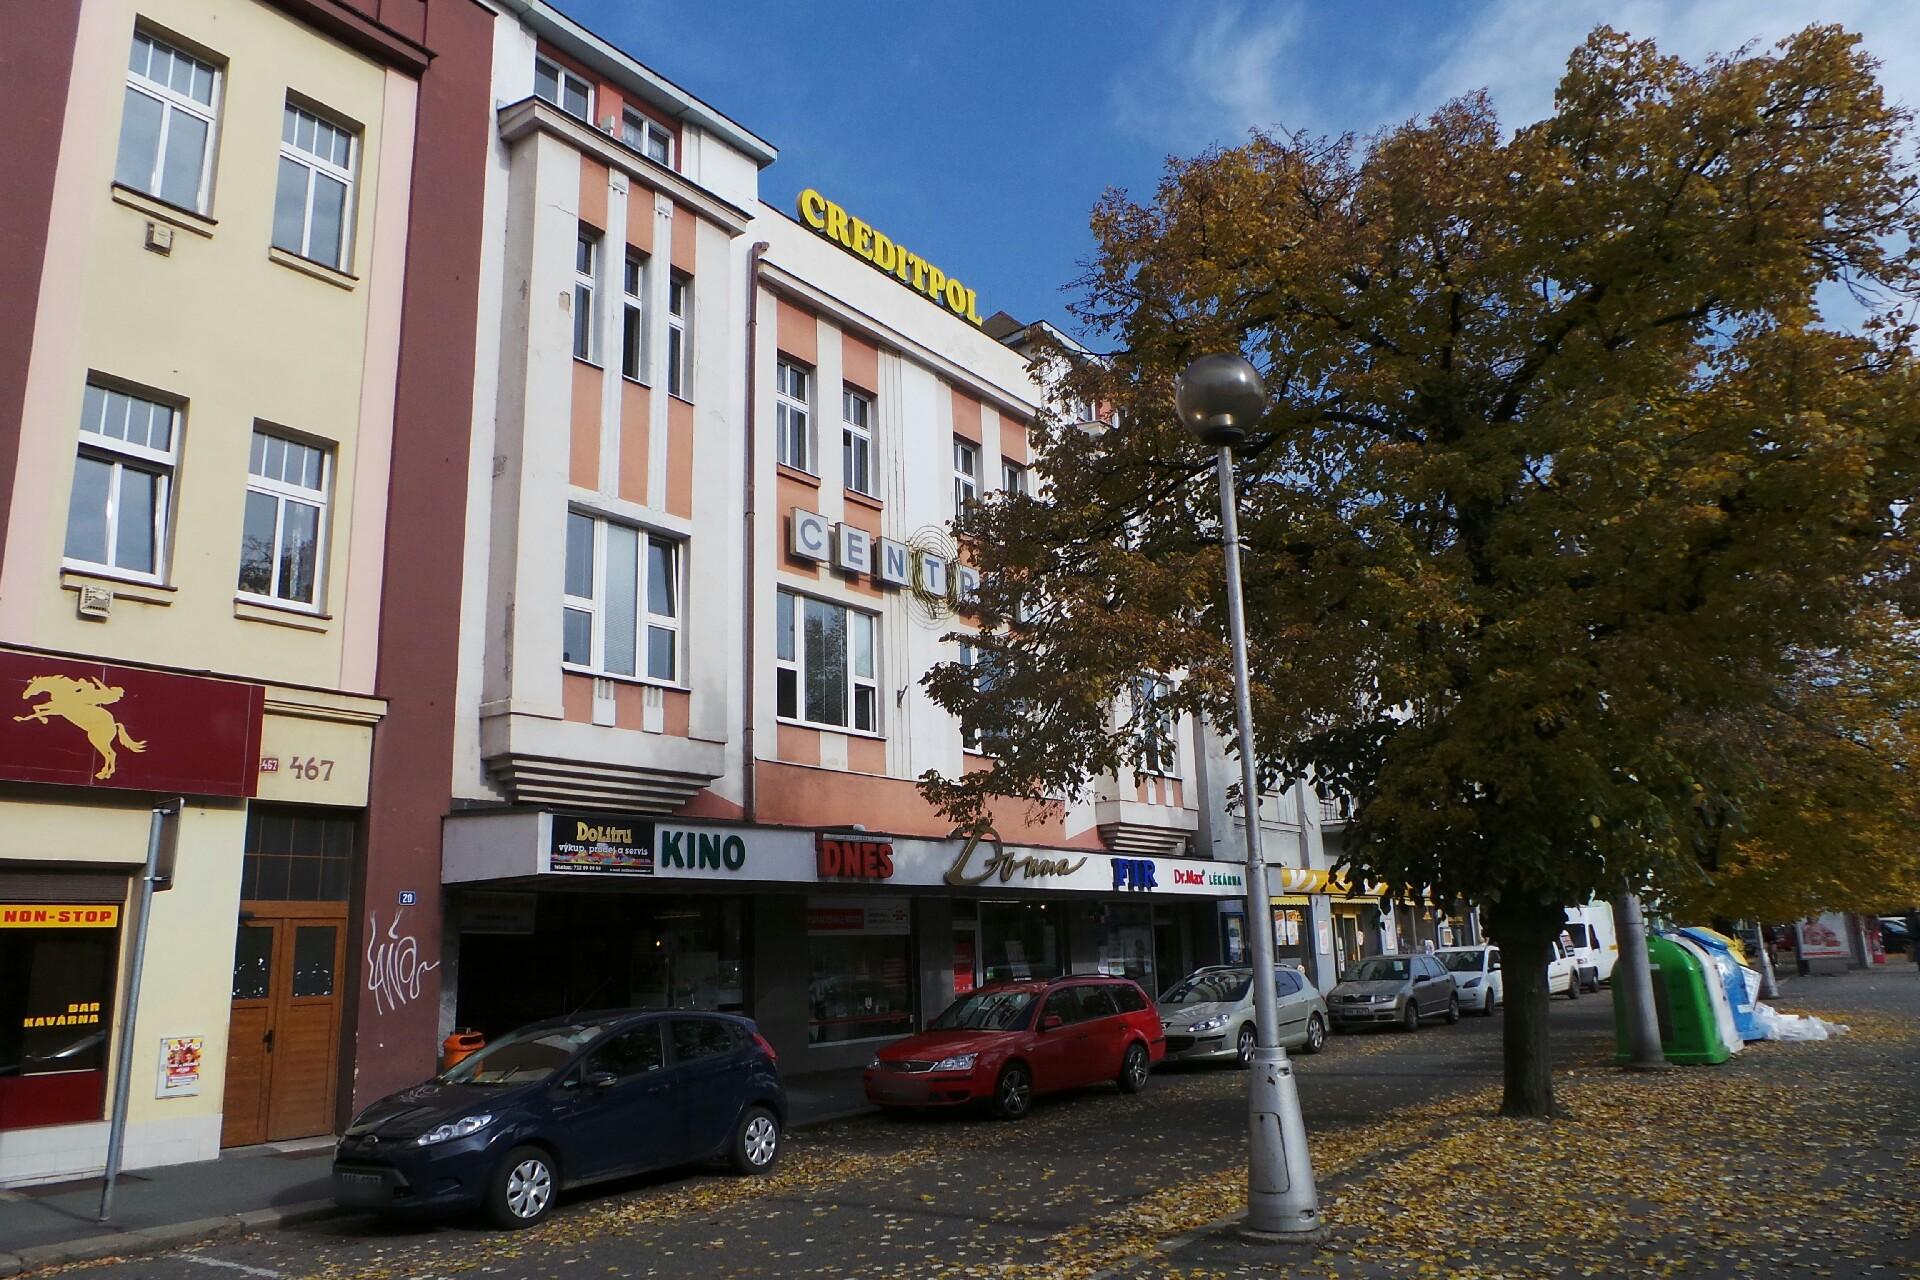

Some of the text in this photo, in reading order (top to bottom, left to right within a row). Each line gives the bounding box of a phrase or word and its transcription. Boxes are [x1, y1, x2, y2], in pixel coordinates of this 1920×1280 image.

[797, 188, 983, 326] CREDITPOL
[262, 759, 278, 771] 467
[290, 756, 335, 781] 467
[558, 842, 649, 856] výkup, prodej a servis
[661, 830, 746, 870] KINO
[818, 839, 894, 878] DNES
[1110, 858, 1158, 890] FIR
[1208, 871, 1242, 886] LÉKÁRNA
[402, 893, 413, 904] 20
[4, 910, 113, 923] NON-STOP
[68, 1002, 100, 1013] BAR
[23, 1014, 99, 1028] KAVÁRNA
